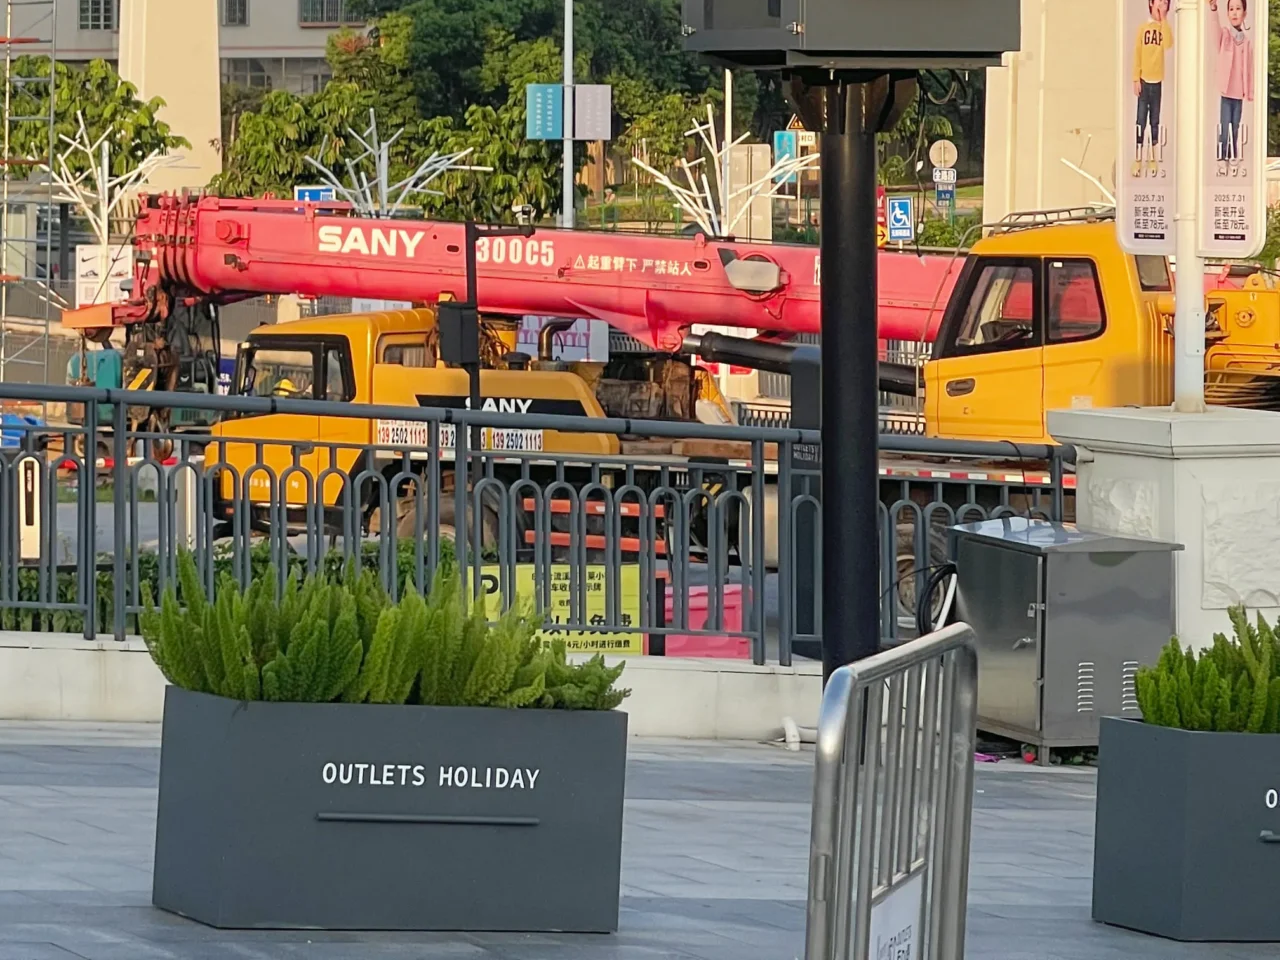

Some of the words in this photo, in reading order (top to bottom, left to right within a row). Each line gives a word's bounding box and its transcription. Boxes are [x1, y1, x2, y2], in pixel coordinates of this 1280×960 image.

[1144, 29, 1163, 46] GAP
[1134, 194, 1165, 202] 2025.7.31
[1214, 194, 1246, 202] 2025.7.31
[1134, 206, 1165, 218] 新装开业
[1214, 206, 1246, 218] 新装开业
[318, 227, 426, 258] SANY
[587, 254, 638, 272] 起重臂下
[641, 258, 692, 276] 严禁站人
[378, 427, 390, 444] 139
[391, 427, 408, 445] 2502
[409, 427, 427, 445] 1113
[492, 431, 505, 449] 139
[506, 432, 524, 450] 2502
[525, 433, 542, 451] 1113
[322, 762, 425, 786] OUTLETS
[439, 766, 540, 789] HOLIDAY
